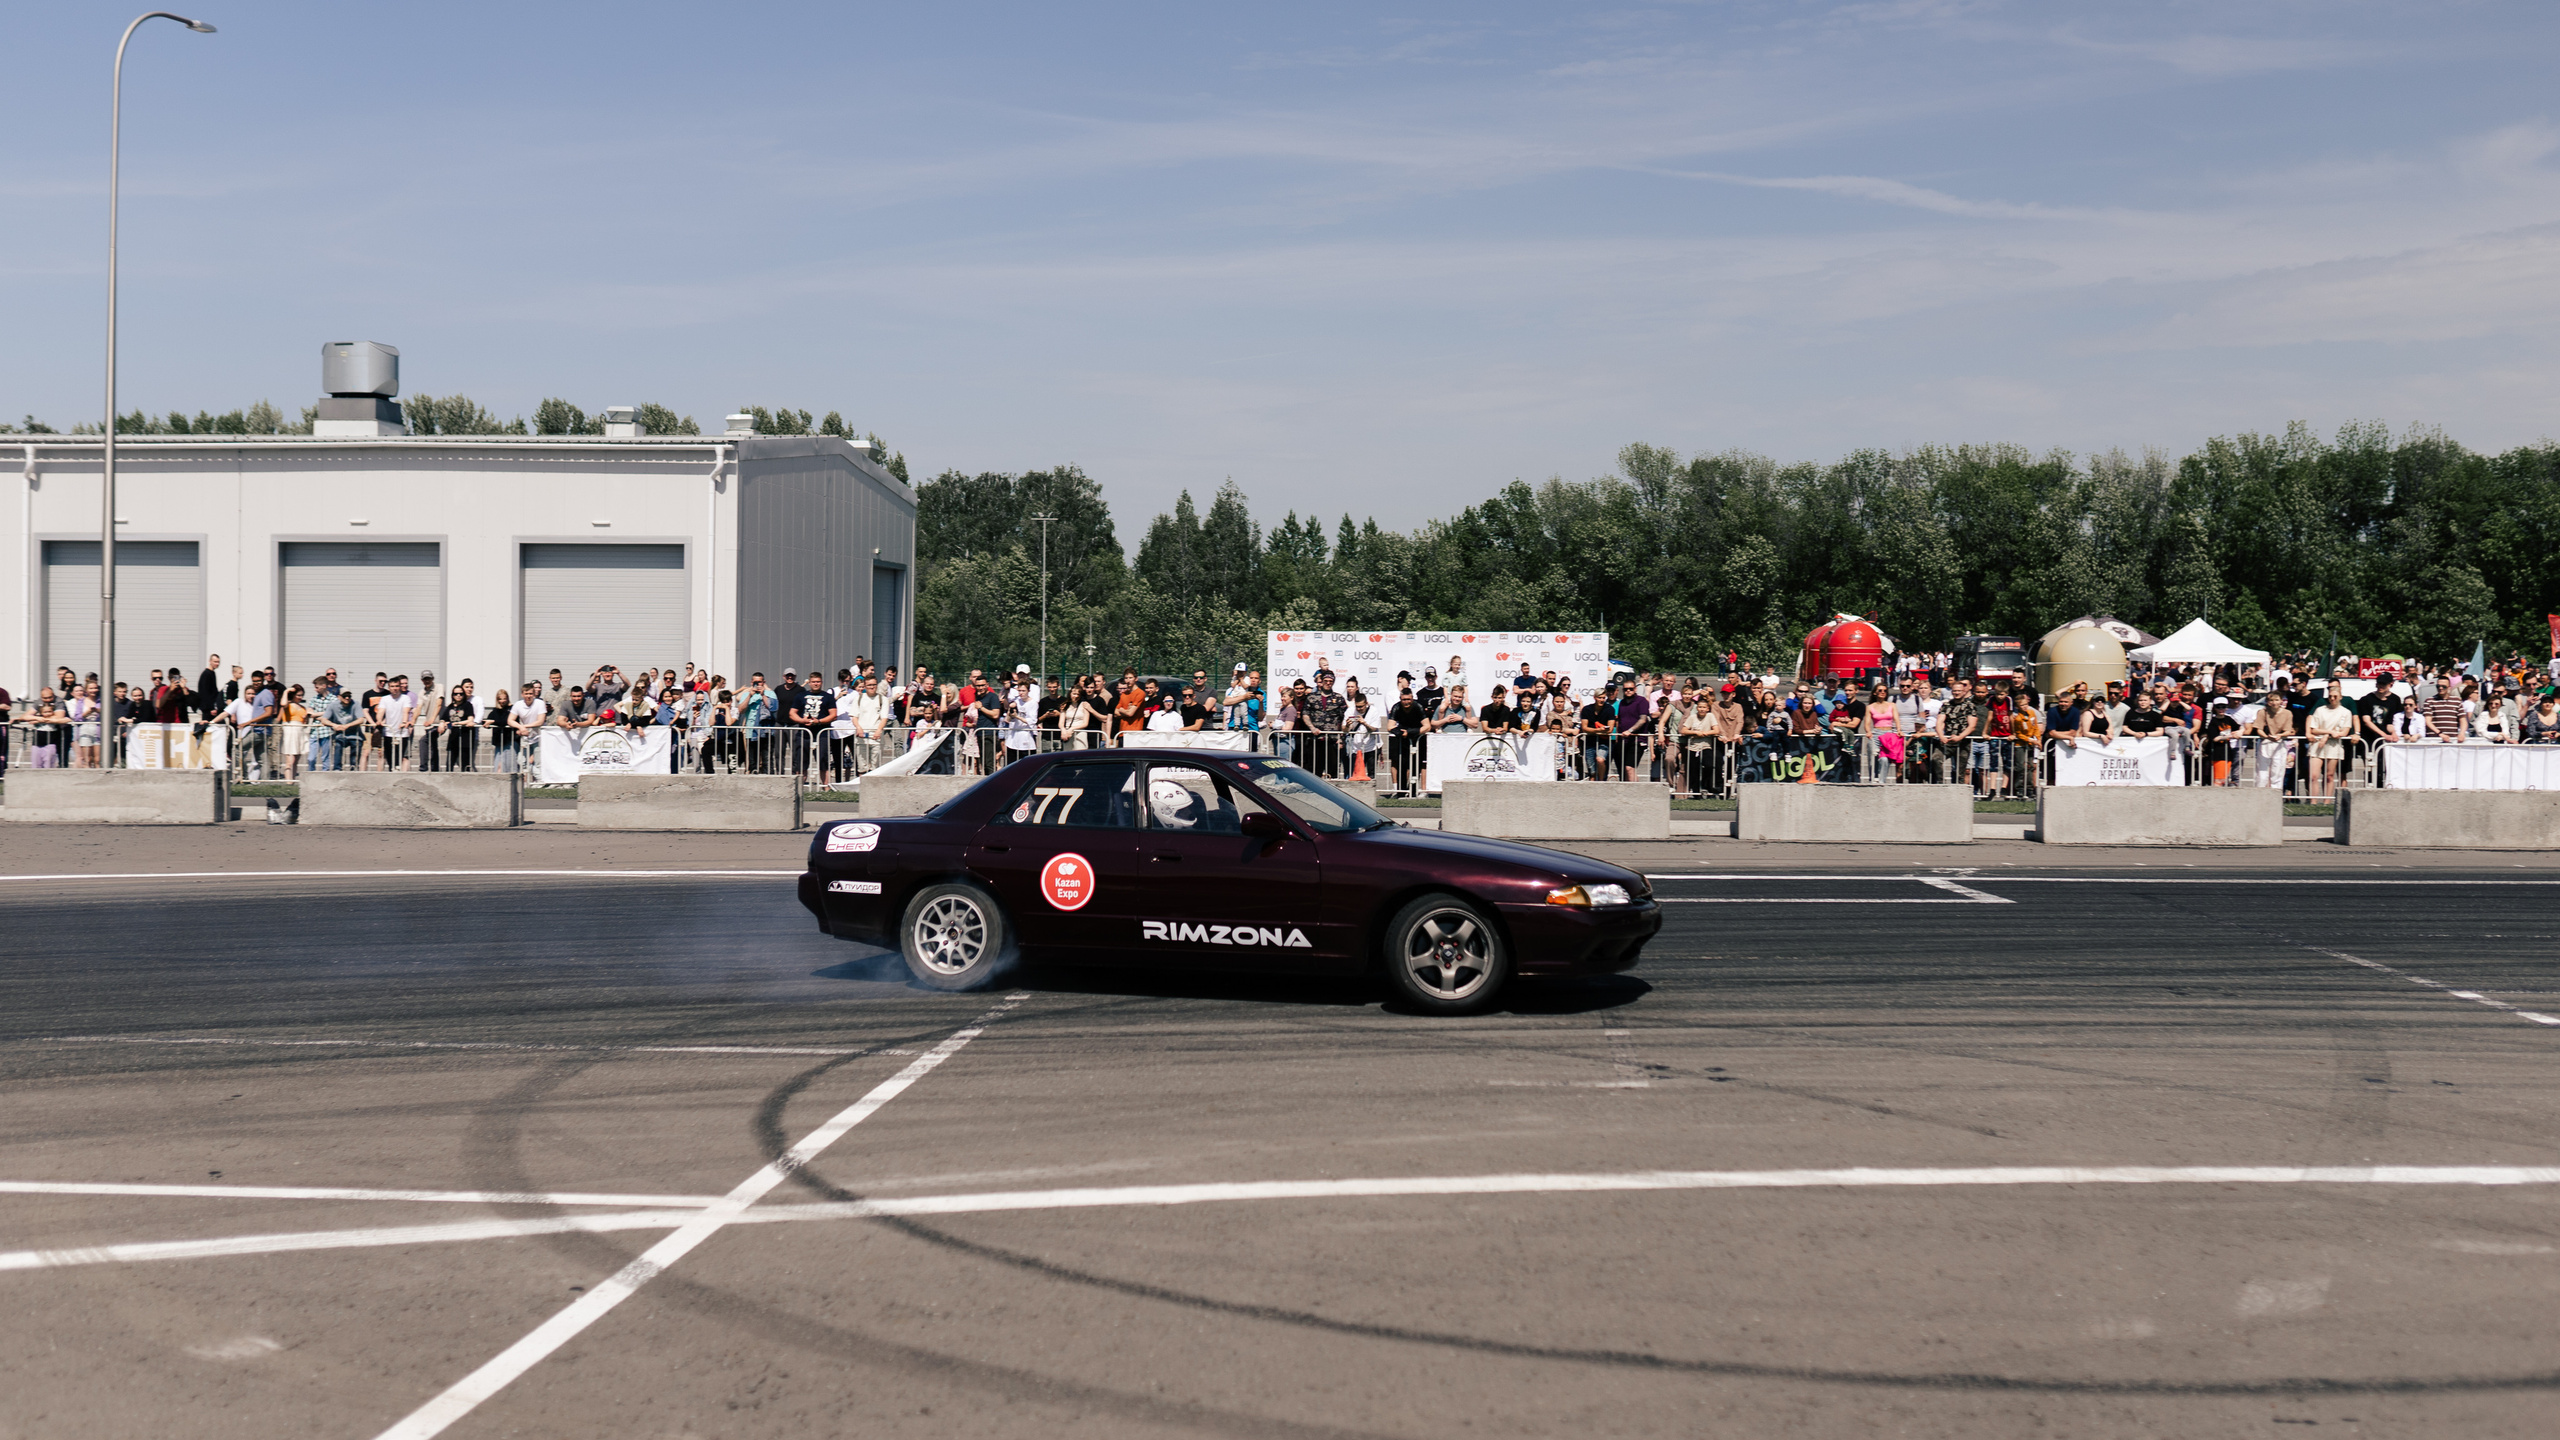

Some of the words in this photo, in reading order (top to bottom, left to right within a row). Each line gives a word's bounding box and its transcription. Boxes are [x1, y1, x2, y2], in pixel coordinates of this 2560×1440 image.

[1331, 633, 1360, 643] UGOL
[1424, 634, 1453, 644] UGOL
[1517, 634, 1546, 644] UGOL
[1354, 651, 1382, 660] UGOL
[1574, 652, 1604, 662] UGOL
[1274, 668, 1303, 677] UGOL
[1360, 687, 1382, 696] GOL
[2102, 758, 2139, 769] БЕЛЫЙ
[2100, 769, 2141, 780] КРЕМЛЬ
[1032, 787, 1084, 825] 77
[826, 842, 876, 852] CHERY
[1055, 877, 1081, 888] Kazan
[1057, 888, 1079, 901] Expo
[1142, 920, 1313, 948] RIMZONA
